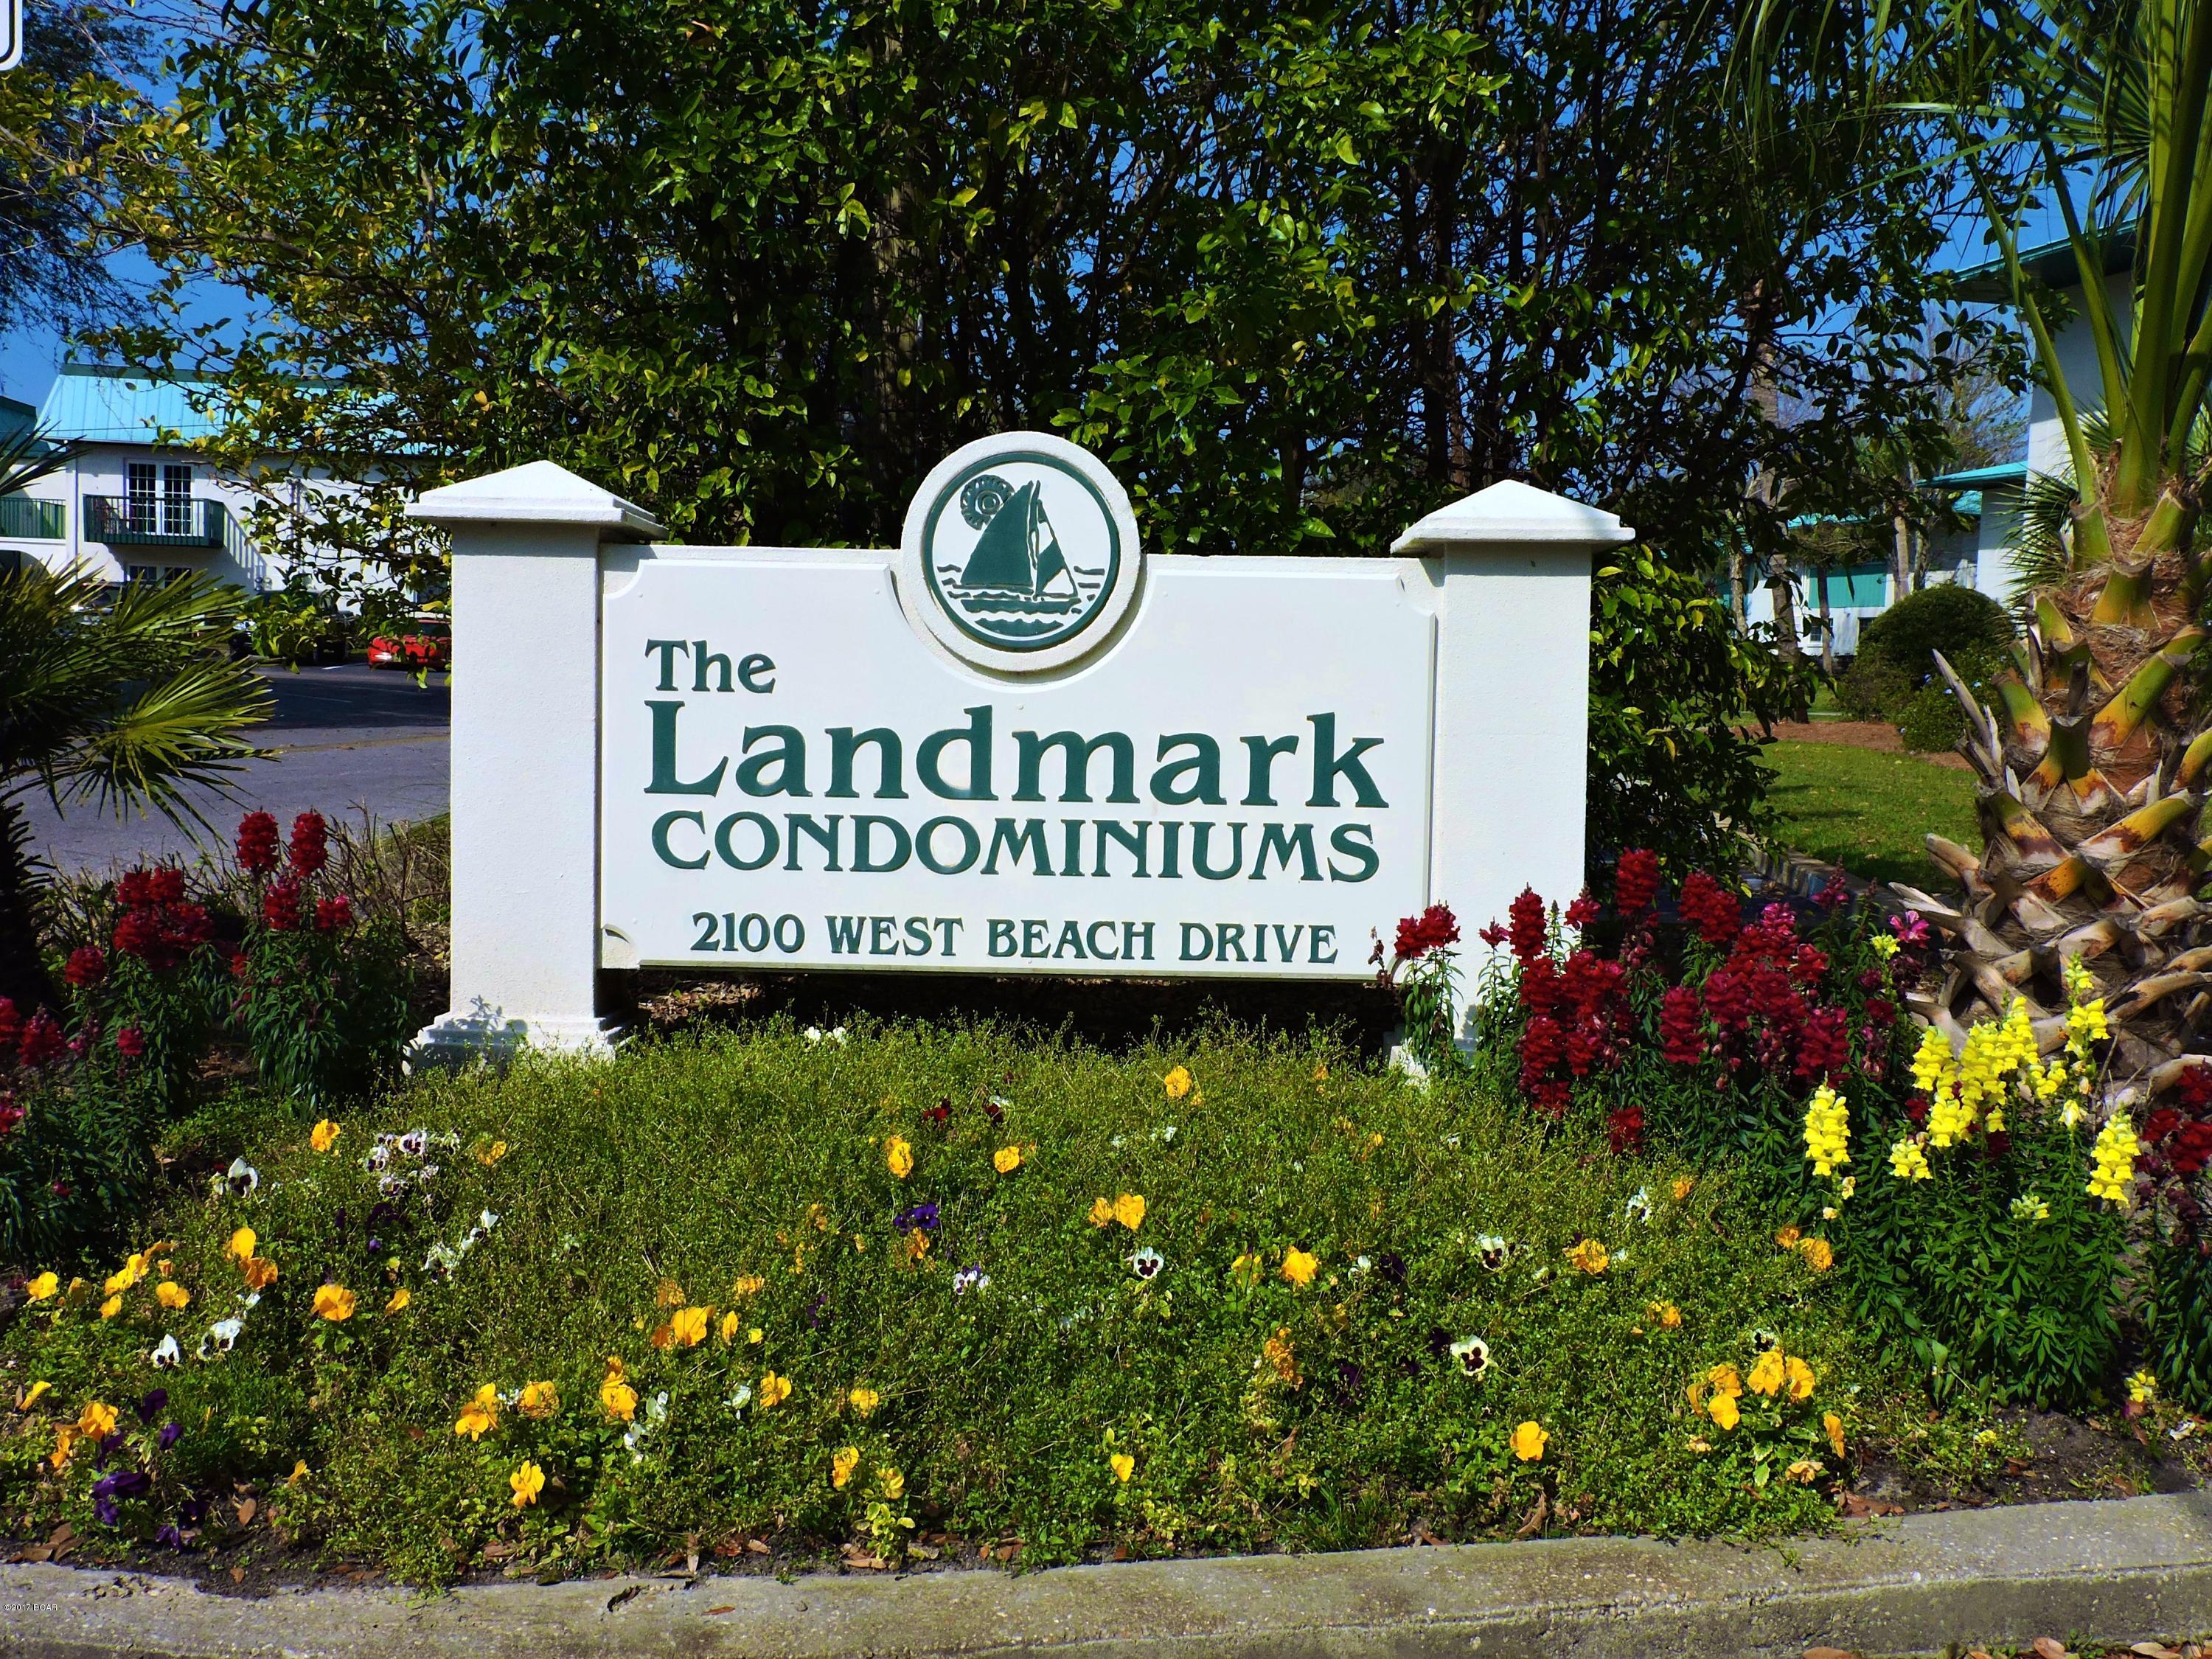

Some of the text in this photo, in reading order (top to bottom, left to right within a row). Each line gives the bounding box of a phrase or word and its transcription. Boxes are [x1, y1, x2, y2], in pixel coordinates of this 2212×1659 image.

[644, 639, 776, 694] The
[643, 700, 1390, 809] Landmark
[651, 810, 1380, 883] CONDOMINIUMS
[690, 911, 1338, 964] 2100 WEST BEACH DRIVE
